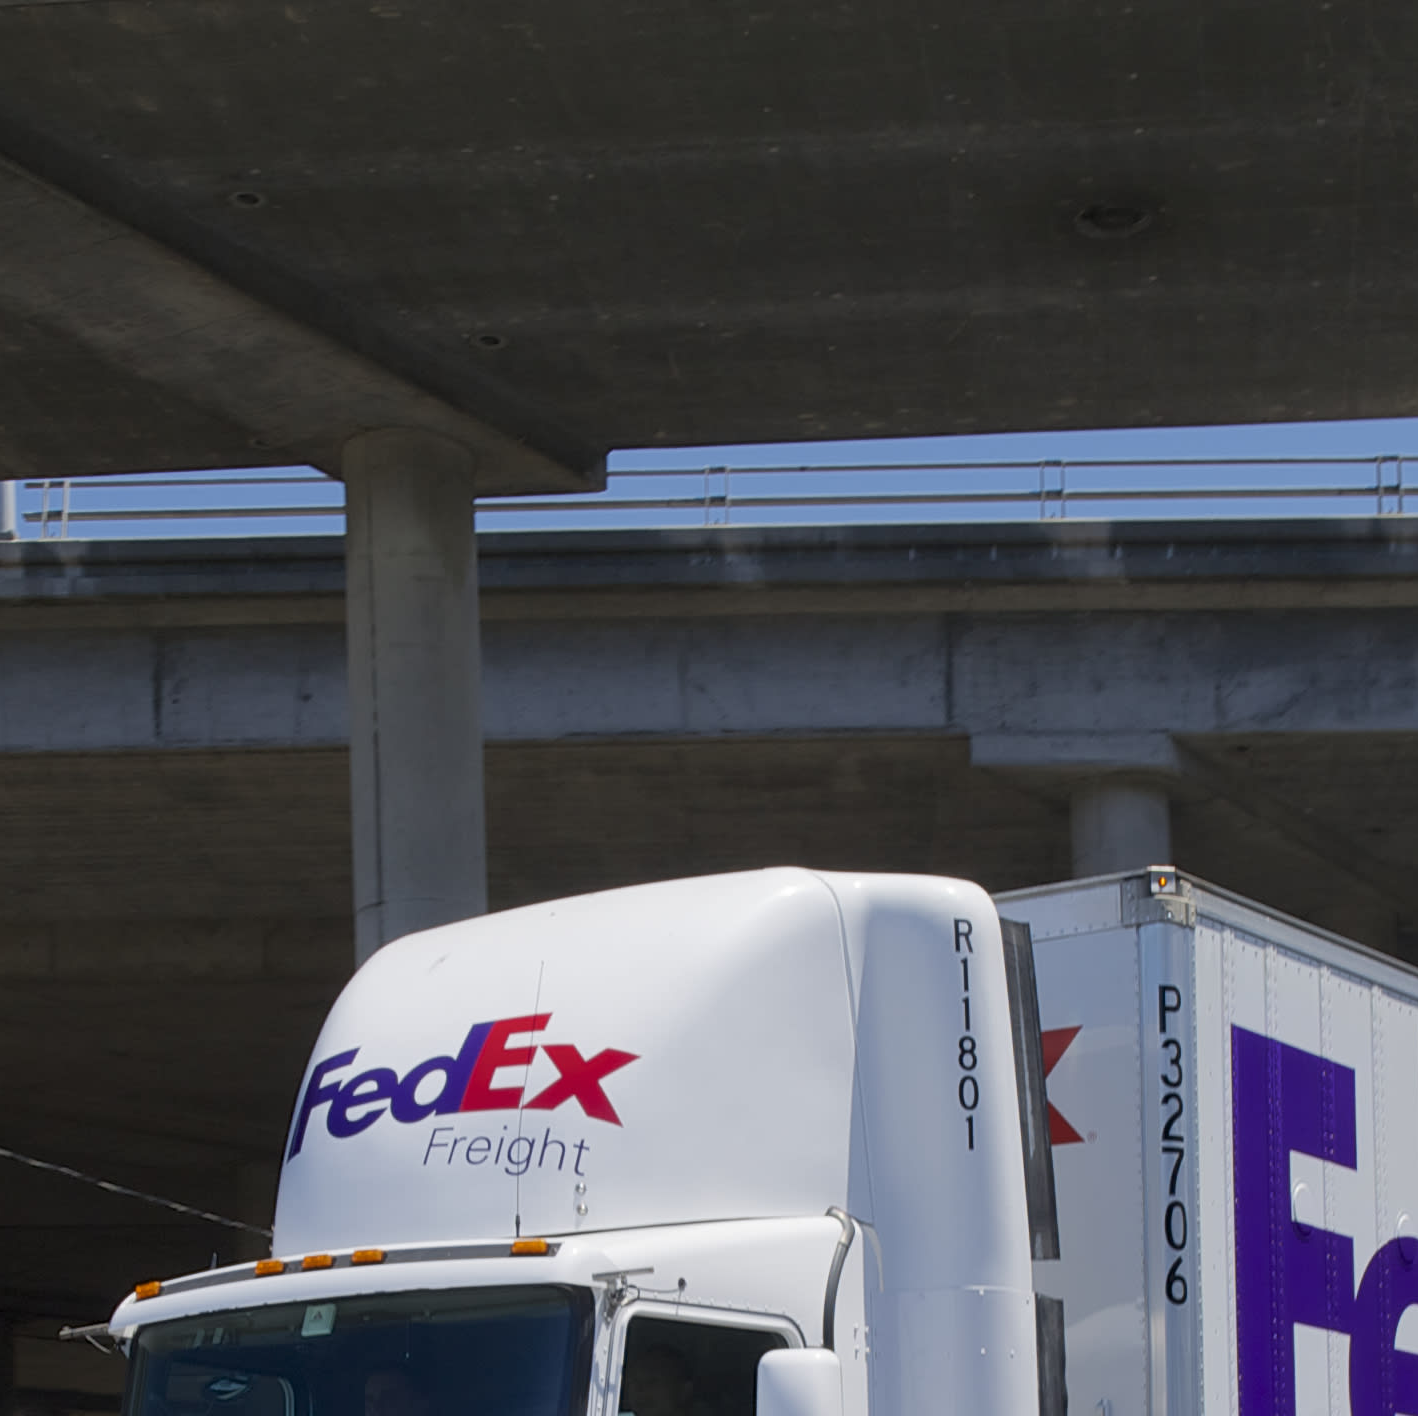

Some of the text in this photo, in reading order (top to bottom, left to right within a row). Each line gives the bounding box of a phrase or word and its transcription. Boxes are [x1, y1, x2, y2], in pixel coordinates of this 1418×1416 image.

[286, 1012, 642, 1166] FedEx
[953, 918, 979, 1151] R11801
[423, 1124, 590, 1177] Freight
[1158, 984, 1188, 1306] P32706
